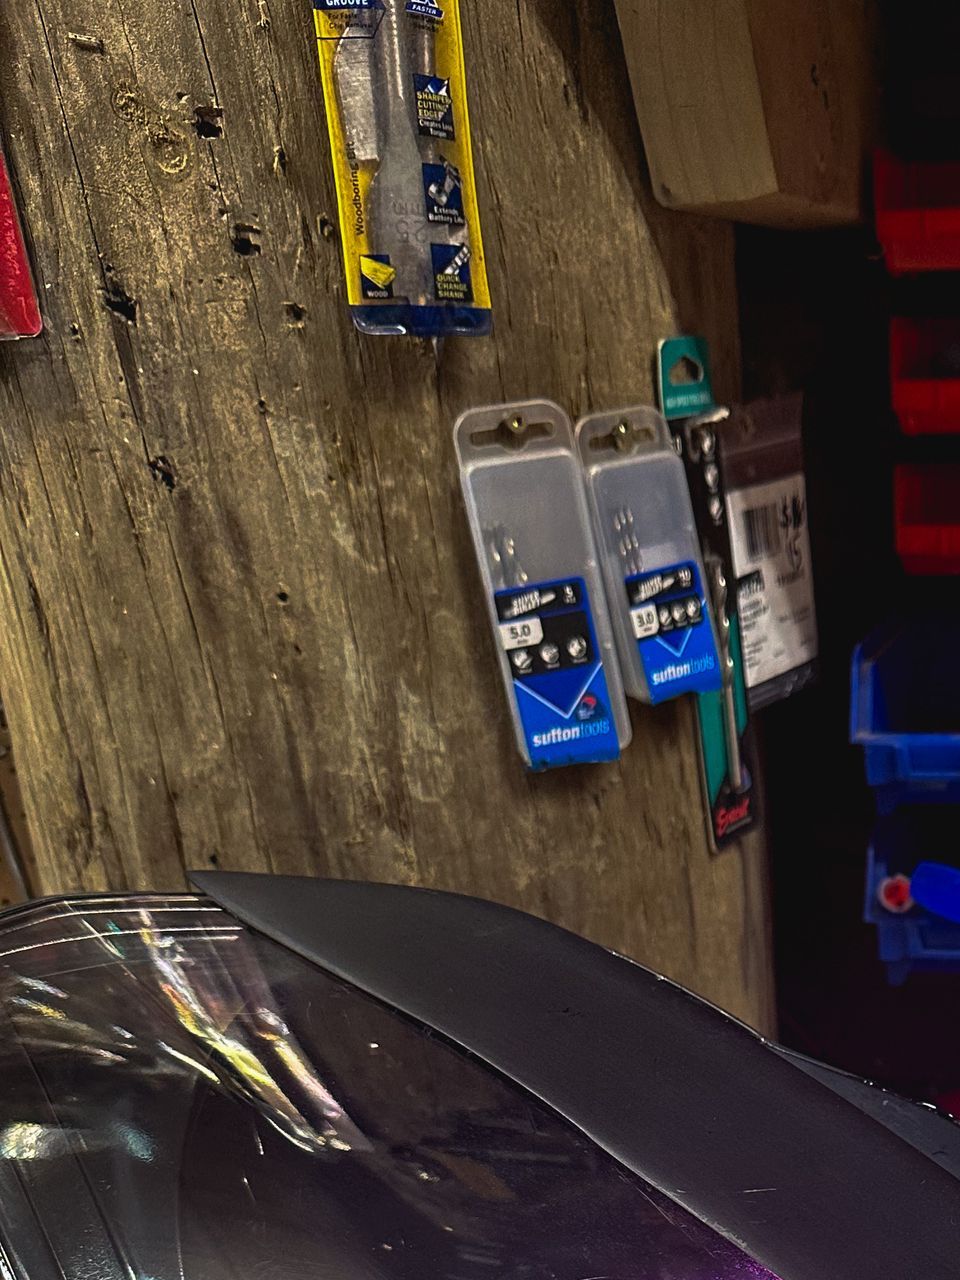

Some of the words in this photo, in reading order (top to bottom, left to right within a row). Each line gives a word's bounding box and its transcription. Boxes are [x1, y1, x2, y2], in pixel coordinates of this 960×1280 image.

[349, 161, 365, 236] Woodboring
[367, 290, 388, 298] WOOD
[510, 624, 531, 640] 5.0
